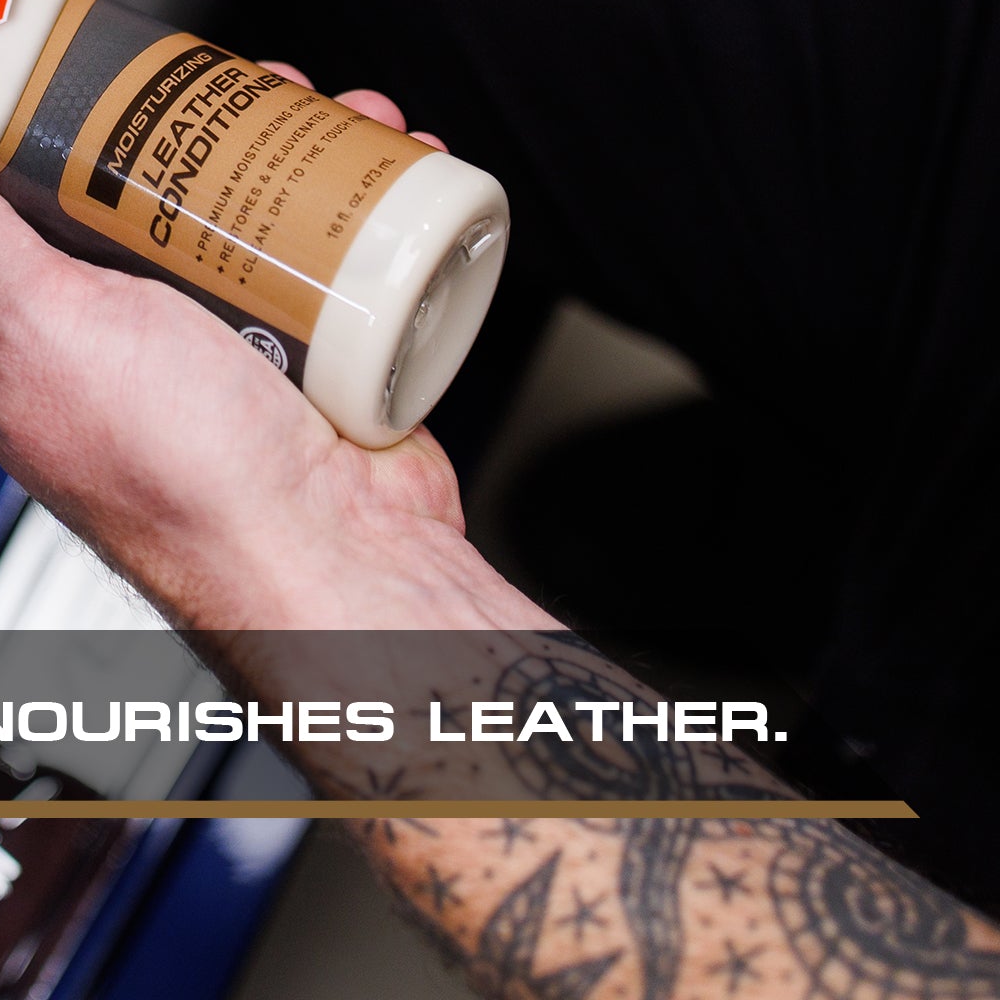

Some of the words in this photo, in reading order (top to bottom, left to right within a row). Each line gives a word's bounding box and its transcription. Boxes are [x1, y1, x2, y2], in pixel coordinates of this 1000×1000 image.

[106, 52, 213, 176] MOISTURIZING
[141, 67, 249, 190] LEATHER
[149, 73, 290, 249] CONDITIONER
[229, 110, 293, 183] MOISTURIZING
[259, 174, 271, 184] &
[266, 110, 330, 171] REJUVENATES
[268, 187, 290, 217] DRY
[287, 167, 305, 184] TO
[301, 144, 325, 164] THE
[320, 116, 353, 143] TOUCH
[326, 222, 344, 239] 16
[348, 192, 367, 209] oz.
[361, 168, 382, 189] 473
[378, 157, 396, 171] mL
